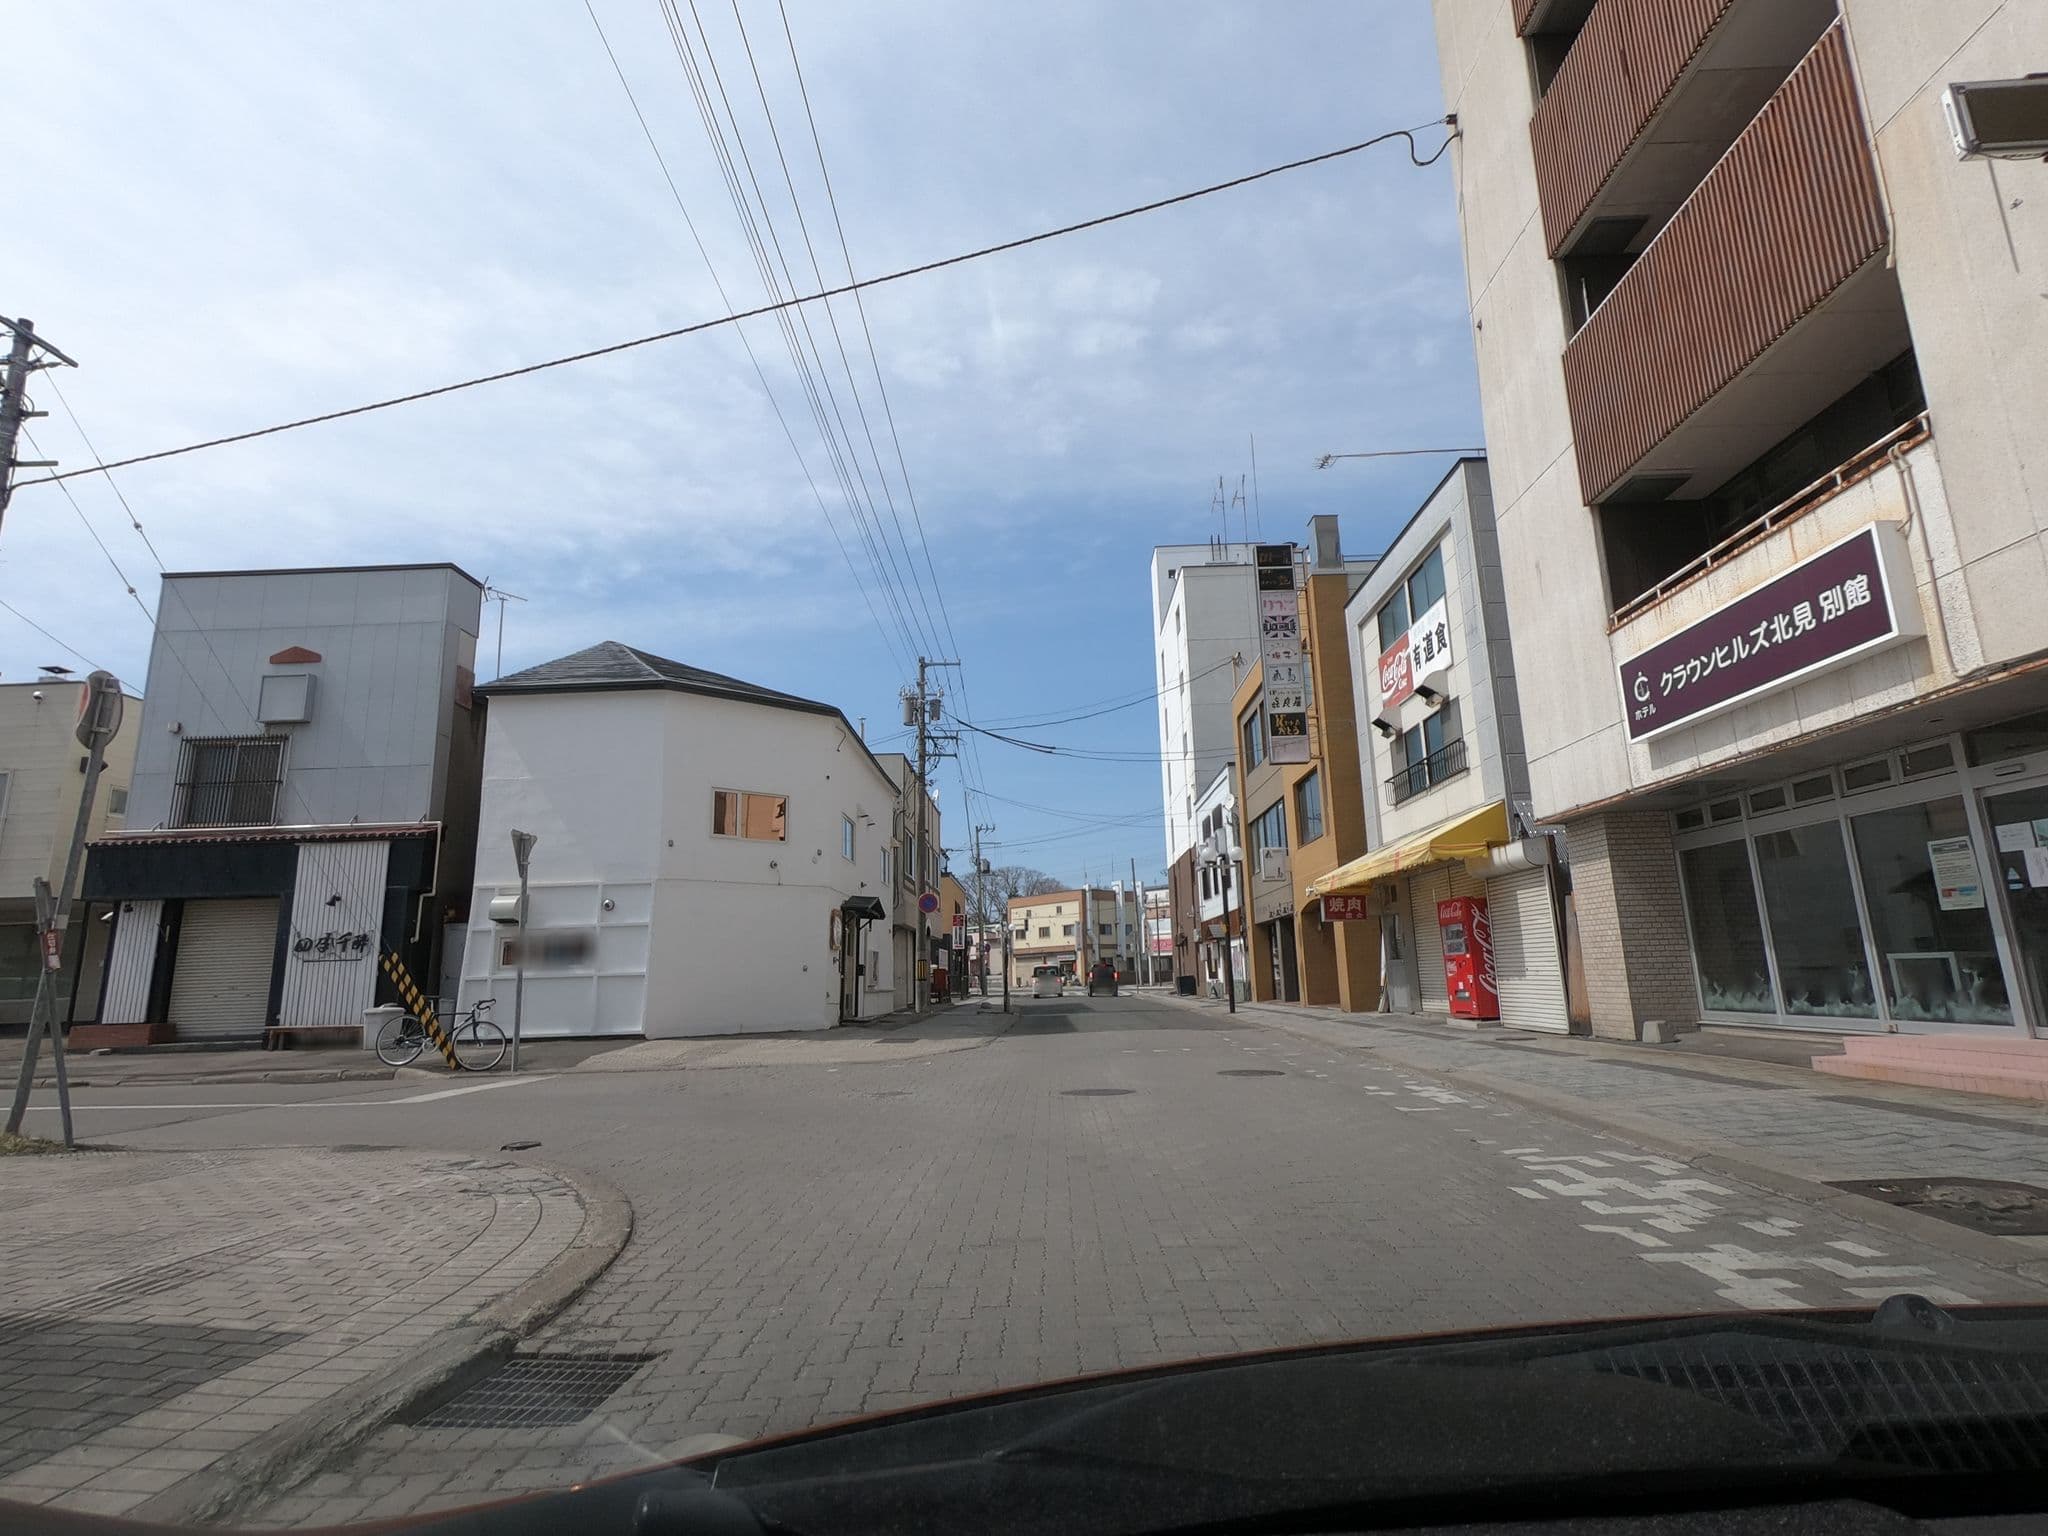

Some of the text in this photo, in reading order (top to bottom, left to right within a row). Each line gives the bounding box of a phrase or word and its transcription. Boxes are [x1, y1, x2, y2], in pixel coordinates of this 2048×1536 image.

[1413, 622, 1448, 672] 有道食
[1660, 573, 1872, 697] クラウンヒルズ北見 別館
[1635, 704, 1657, 720] ホテル
[1329, 897, 1362, 912] 焼肉
